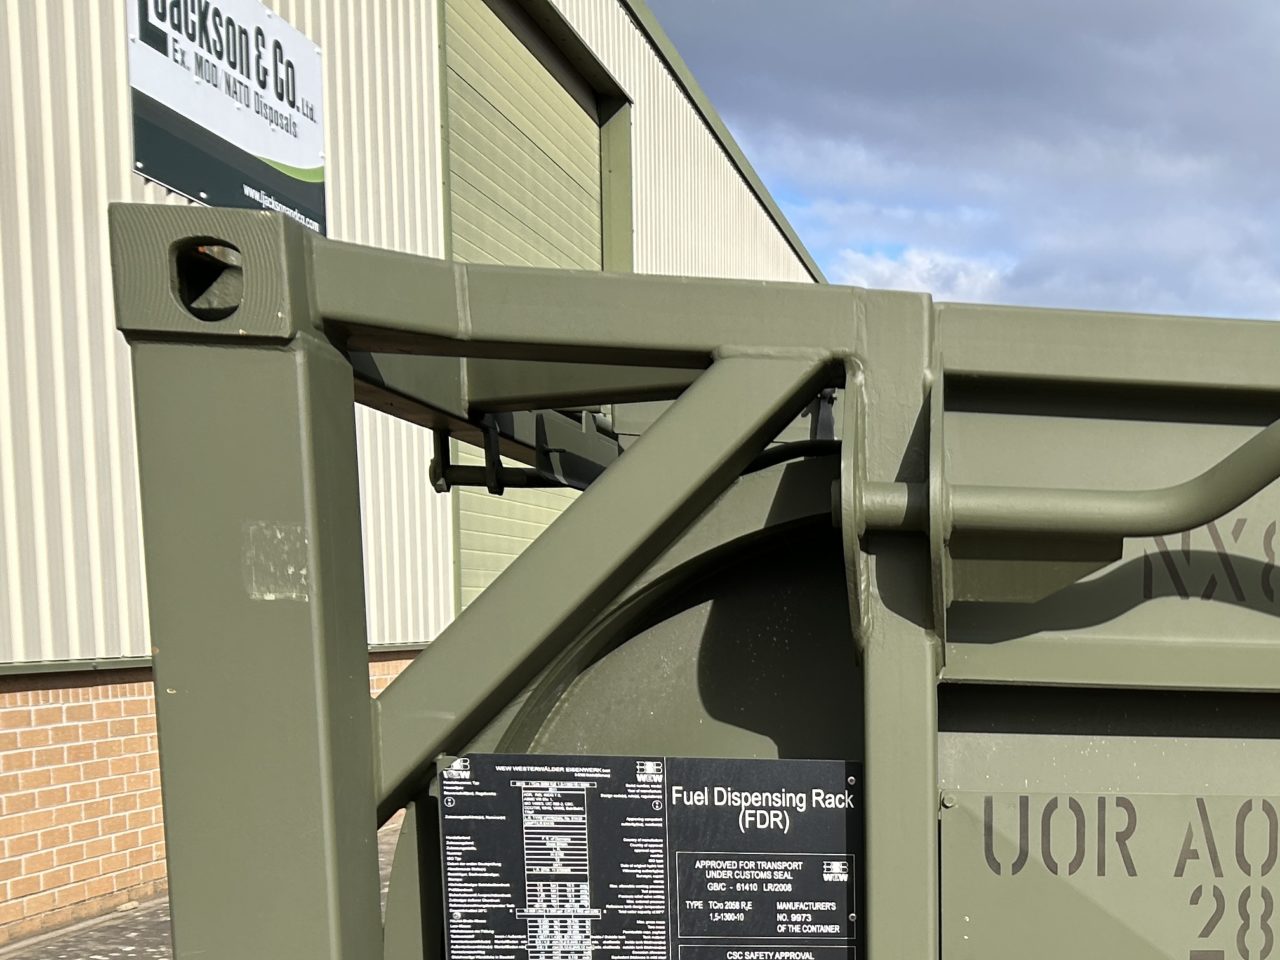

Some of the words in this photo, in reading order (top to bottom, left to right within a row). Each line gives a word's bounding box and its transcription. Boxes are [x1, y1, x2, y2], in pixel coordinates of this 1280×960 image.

[255, 26, 269, 89] &
[273, 38, 300, 112] Co.
[254, 91, 298, 138] Disposals
[671, 786, 709, 806] Fuel
[714, 787, 807, 813] Dispensing
[812, 789, 854, 809] Rack
[738, 810, 790, 834] (FDR)
[983, 795, 1137, 877] UOR
[695, 860, 738, 869] APPROVED
[738, 861, 756, 870] FOR
[757, 861, 803, 870] TRANSPORT
[705, 870, 733, 879] UNDER
[734, 871, 772, 880] CUSTOMS
[773, 871, 793, 880] SEAL
[762, 883, 792, 892] LR/2008
[685, 901, 704, 910] TYPE
[776, 913, 789, 922] NO.
[791, 914, 812, 922] 9973
[776, 924, 787, 933] OF
[787, 924, 801, 934] THE
[802, 924, 841, 934] CONTAINER
[726, 951, 744, 960] CSC
[744, 951, 774, 960] SAFETY
[774, 951, 815, 960] APPROVAL
